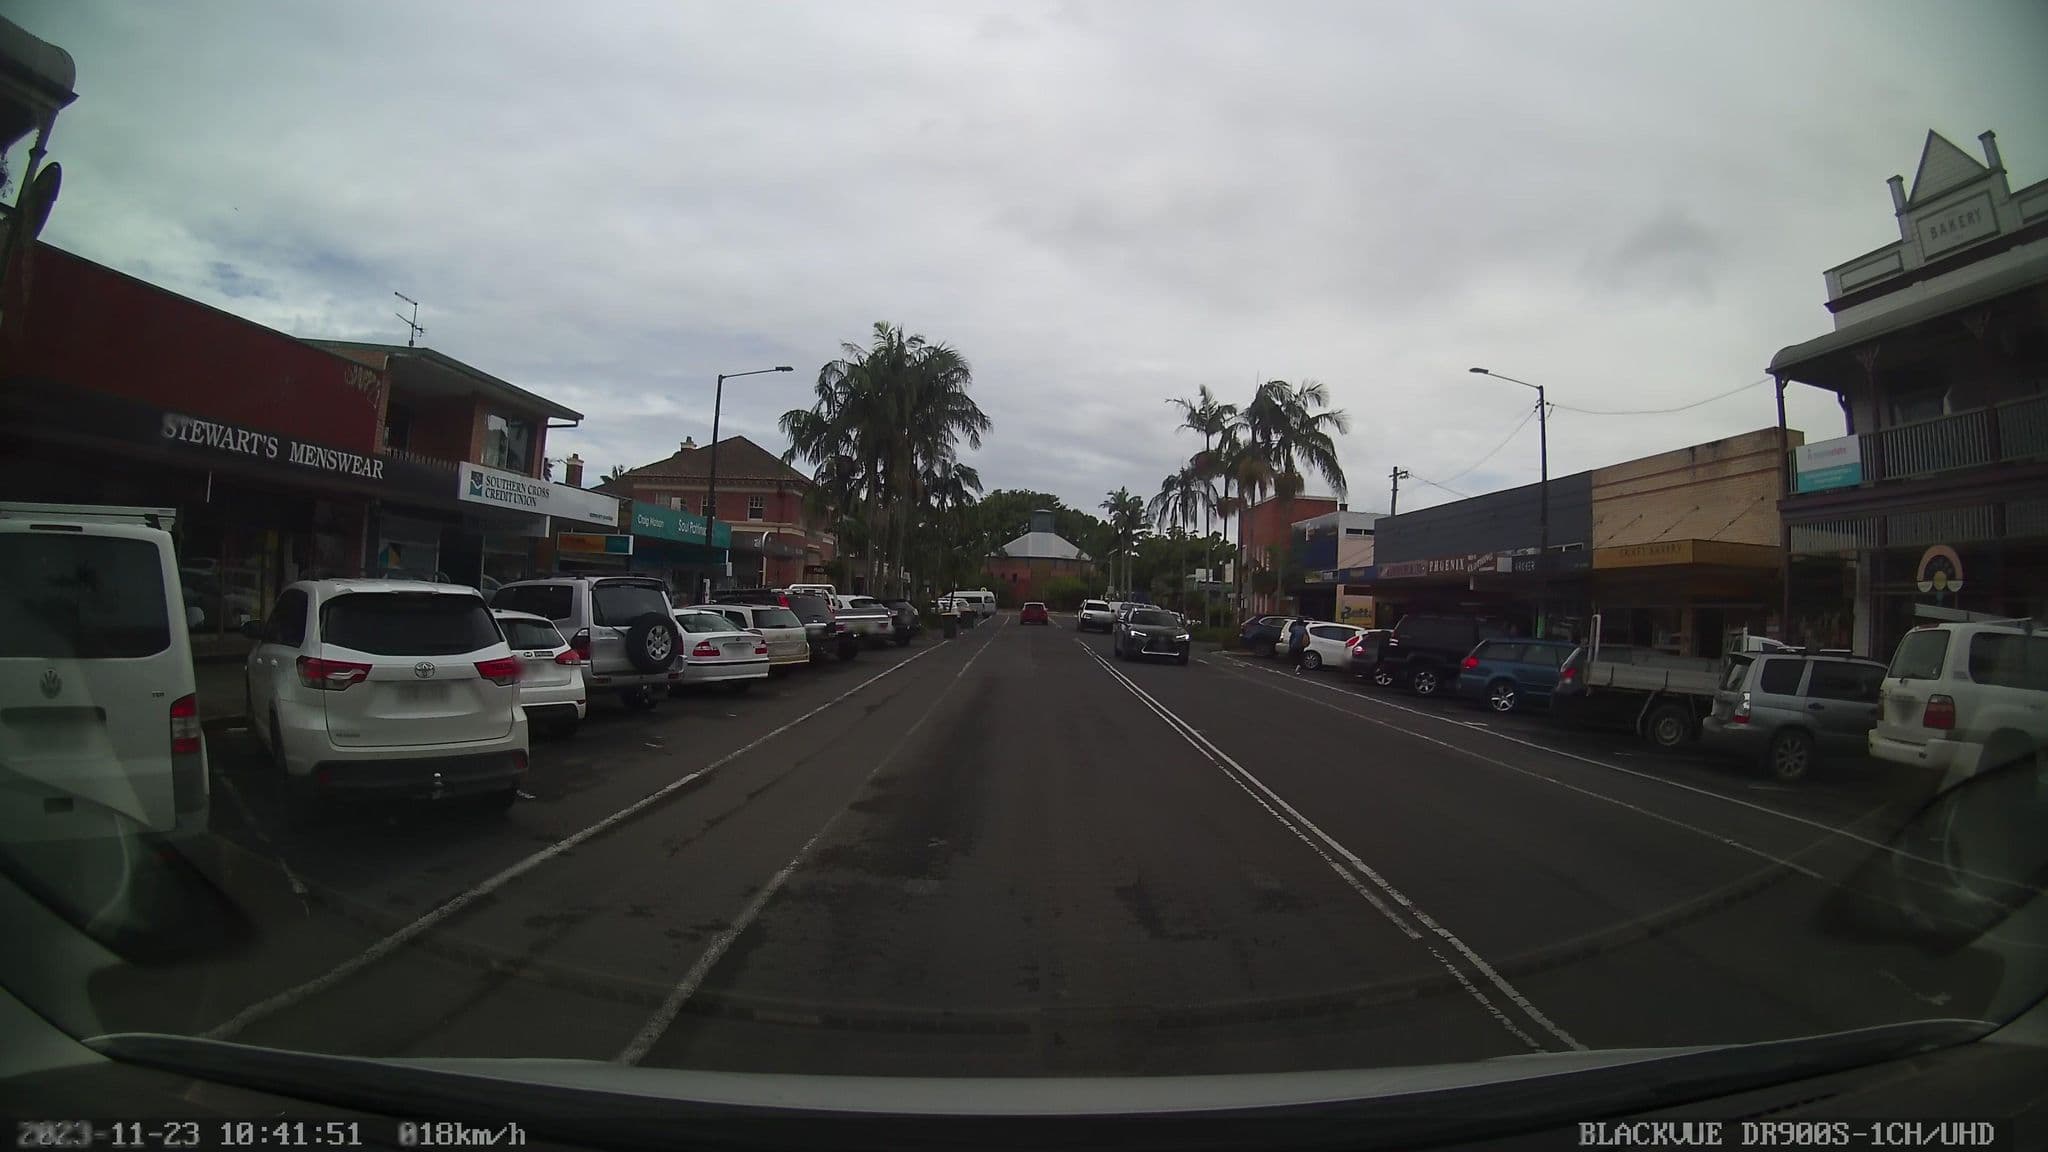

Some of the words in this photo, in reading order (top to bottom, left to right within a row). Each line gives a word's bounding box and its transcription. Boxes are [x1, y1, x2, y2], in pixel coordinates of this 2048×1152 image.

[1930, 208, 1982, 240] BAKERY
[162, 413, 279, 459] STEWART'S
[289, 441, 384, 479] MENSWEAR
[485, 488, 512, 502] CREDIT
[513, 493, 537, 507] UNION
[486, 475, 526, 493] SOUTHERN
[527, 485, 550, 498] CROSS
[1429, 557, 1465, 572] PHOENIX
